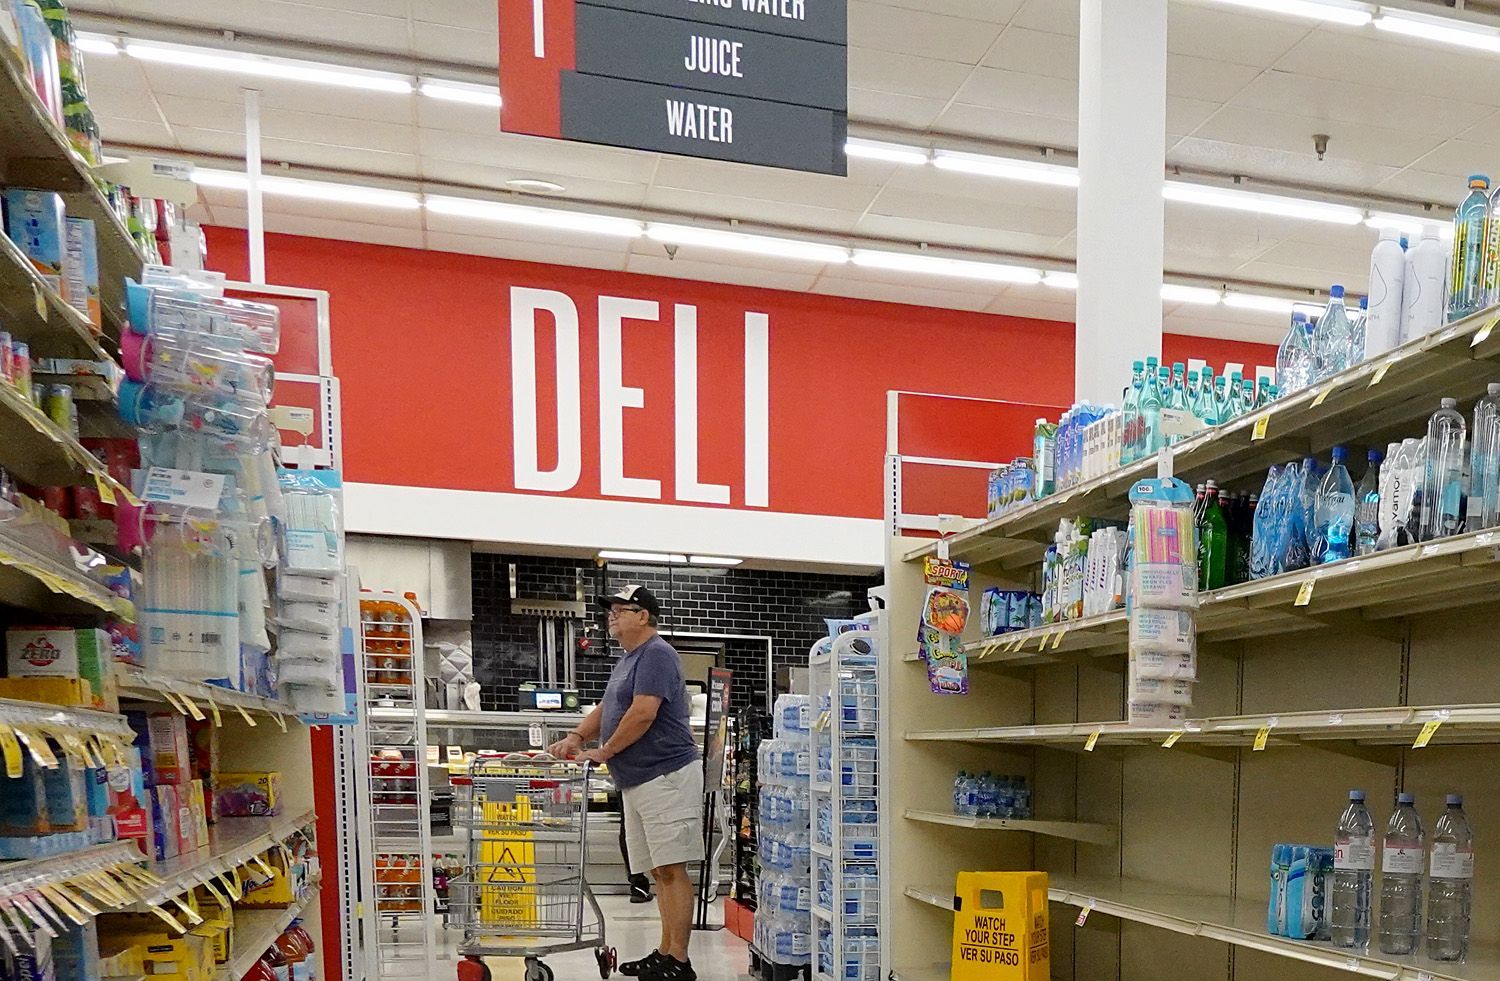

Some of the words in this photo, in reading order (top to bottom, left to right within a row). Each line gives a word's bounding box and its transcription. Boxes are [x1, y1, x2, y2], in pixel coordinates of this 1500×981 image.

[684, 35, 743, 78] JUICE
[666, 99, 733, 144] WATER
[510, 286, 769, 508] DELI
[1392, 476, 1401, 521] vamor
[931, 564, 963, 580] SPORT
[965, 929, 990, 944] YOUR
[991, 931, 1015, 947] STEP
[974, 916, 1006, 931] WATCH
[960, 947, 978, 960] VER
[979, 949, 993, 963] SU
[994, 951, 1019, 966] PASO
